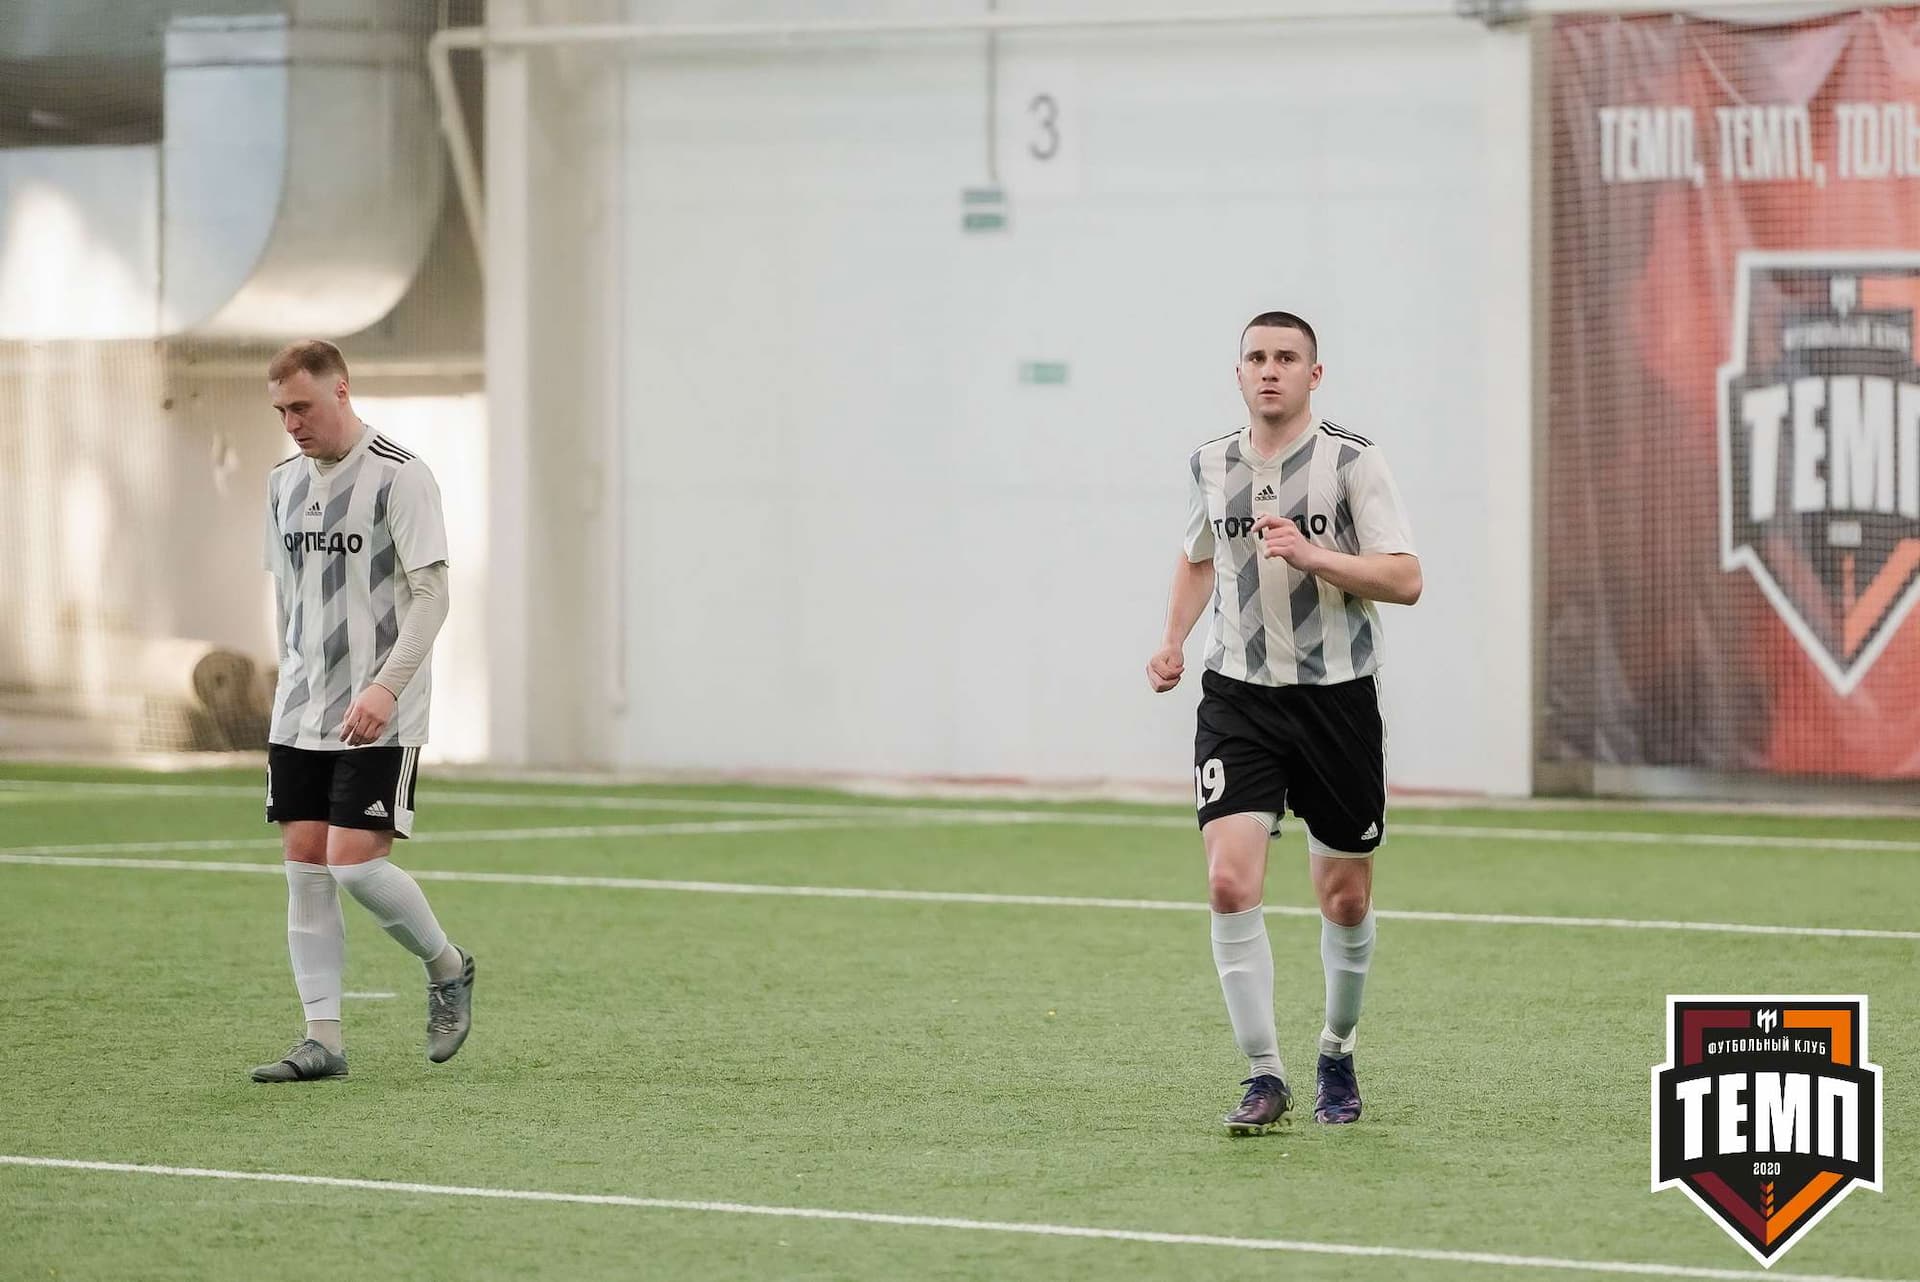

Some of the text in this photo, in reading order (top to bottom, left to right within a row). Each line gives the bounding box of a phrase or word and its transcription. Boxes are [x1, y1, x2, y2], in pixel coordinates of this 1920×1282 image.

[1028, 93, 1060, 160] 3
[1600, 105, 1704, 187] ТЕМП,
[1716, 104, 1826, 188] ТЕМП,
[284, 531, 363, 556] ОРПЕДО
[1213, 514, 1327, 540] ТОРДО
